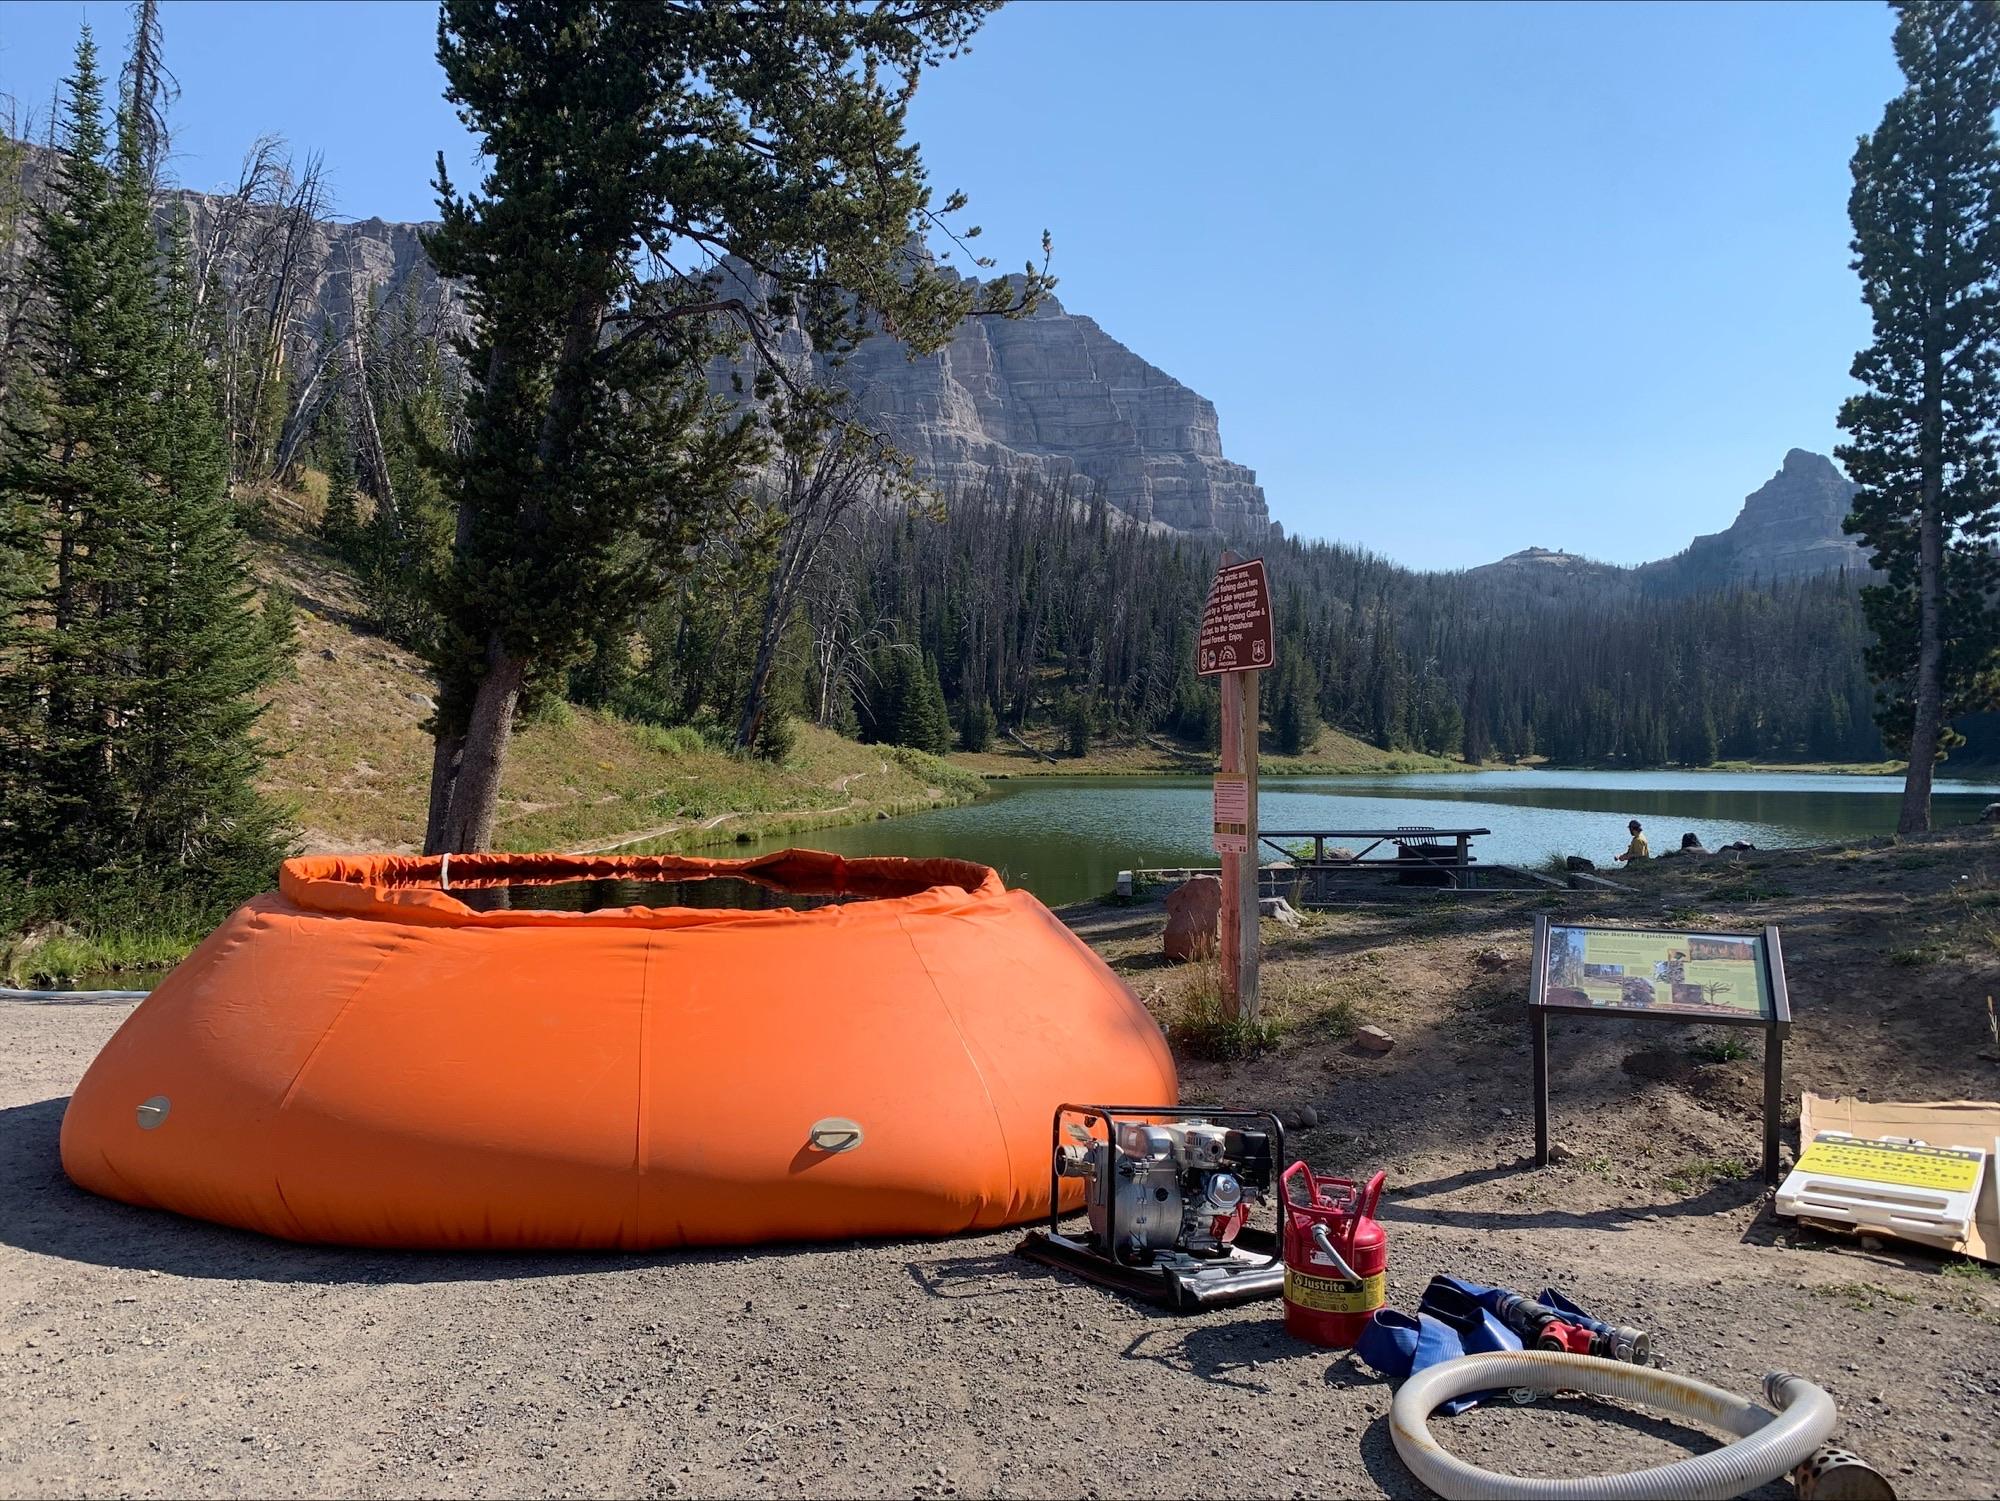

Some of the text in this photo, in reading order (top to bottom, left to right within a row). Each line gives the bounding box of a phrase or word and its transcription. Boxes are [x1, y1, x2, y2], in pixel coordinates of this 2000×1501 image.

[1224, 573, 1238, 583] picnic
[1220, 583, 1236, 592] fishing
[1237, 581, 1248, 589] dock
[1249, 579, 1258, 587] here
[1221, 588, 1258, 602] Lake were made
[1222, 612, 1246, 623] Wyoming
[1246, 610, 1260, 618] Game
[1262, 608, 1265, 616] &
[1220, 624, 1228, 632] the
[1229, 622, 1253, 631] Shoshone
[1229, 633, 1243, 642] Enjoy.
[1641, 933, 1683, 941] Epidemic
[1826, 1137, 1970, 1159] CAUTION!
[1806, 1157, 1969, 1181] APPROACH!
[1831, 1155, 1945, 1172] DO NOT
[1303, 1277, 1345, 1292] Justrite
